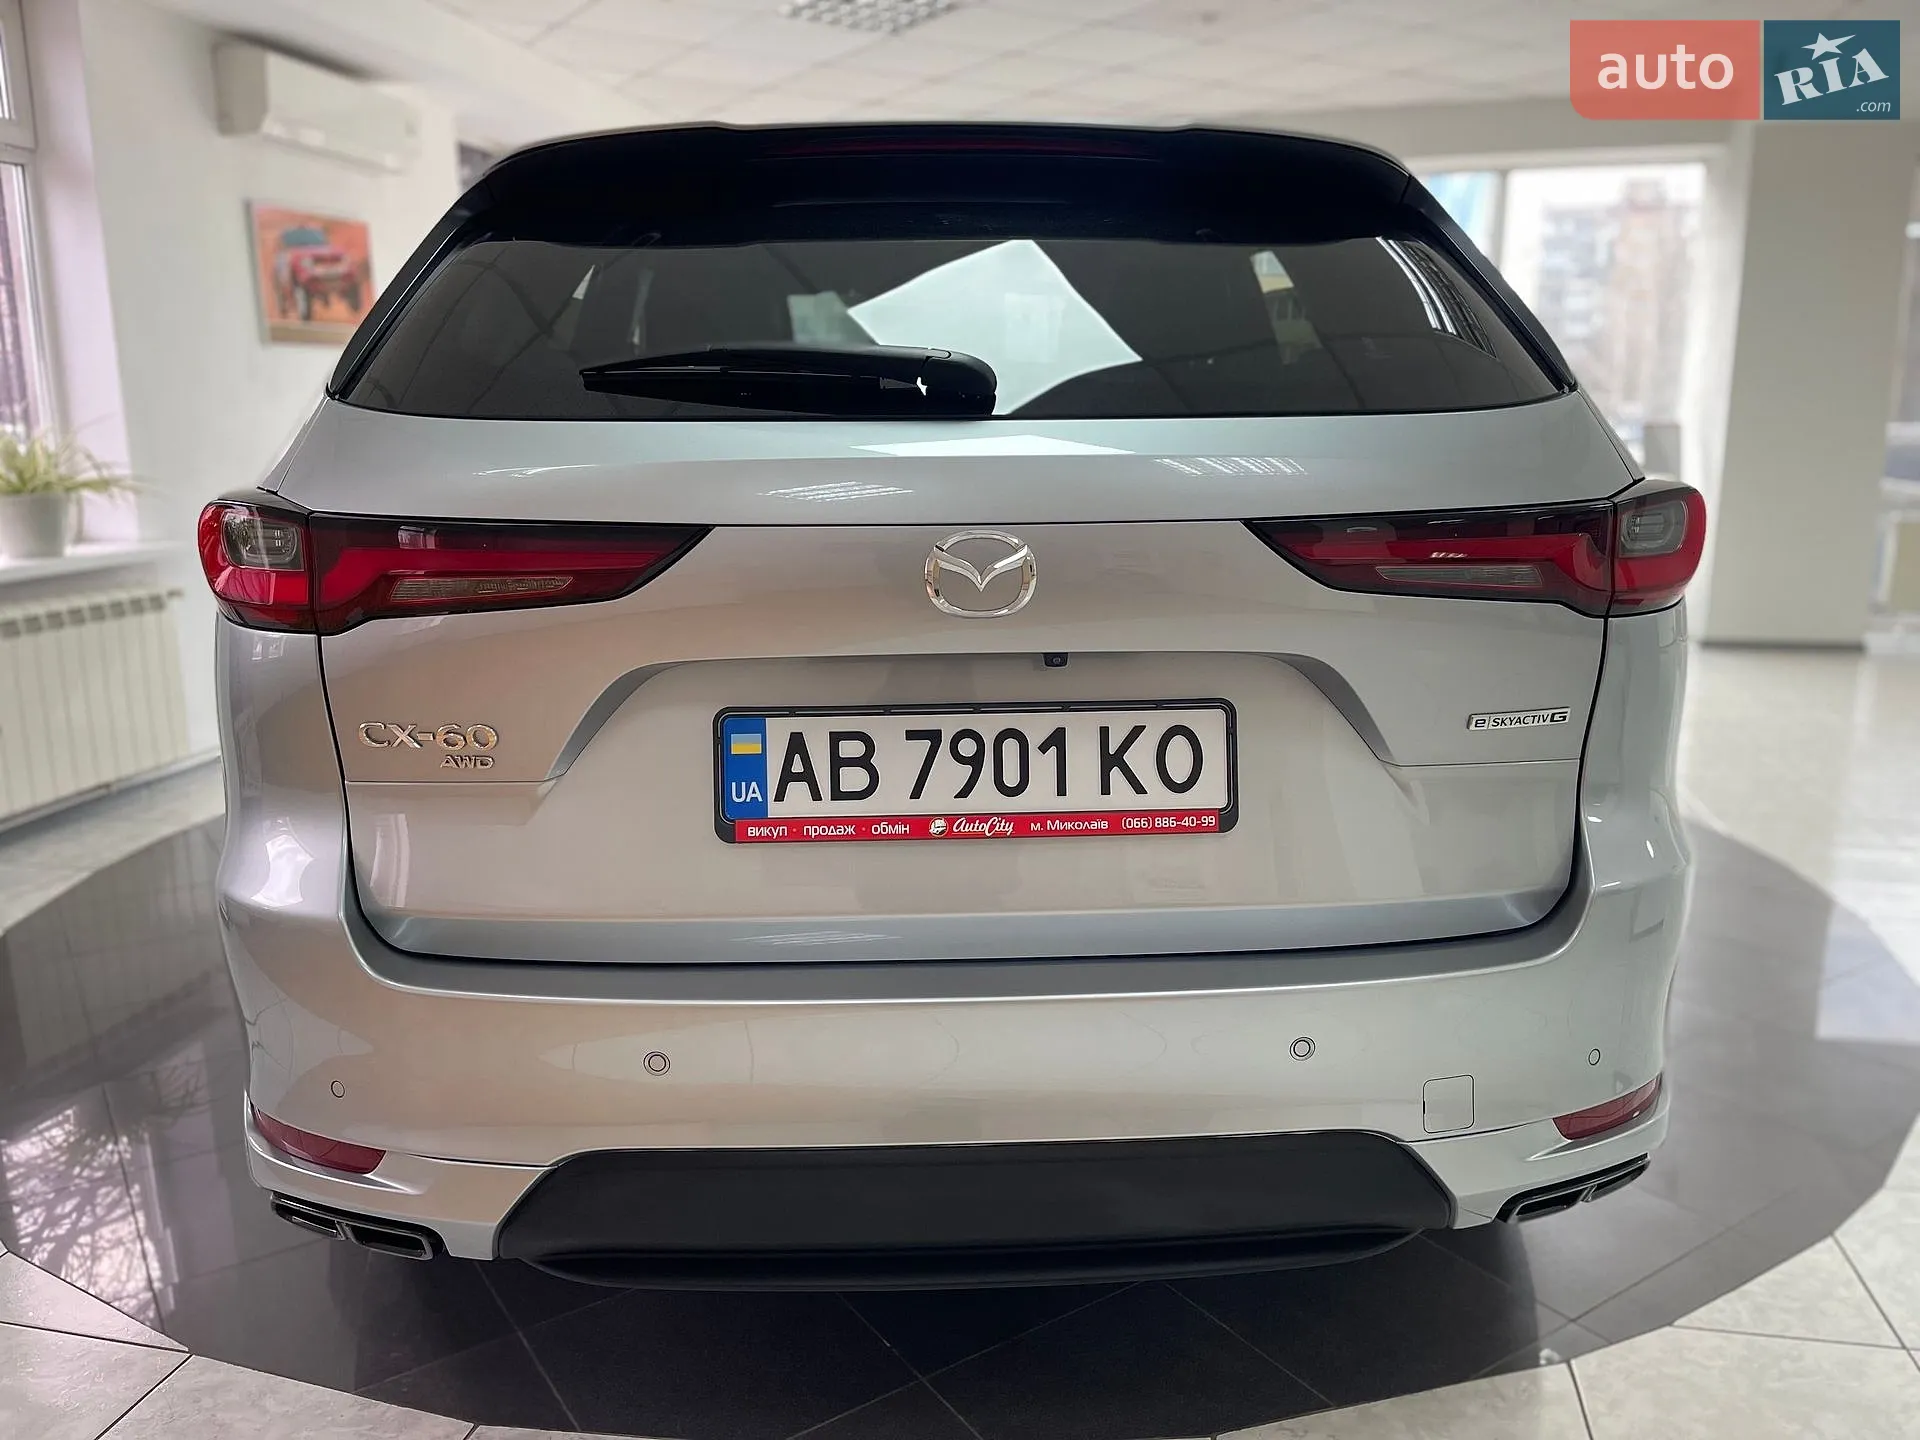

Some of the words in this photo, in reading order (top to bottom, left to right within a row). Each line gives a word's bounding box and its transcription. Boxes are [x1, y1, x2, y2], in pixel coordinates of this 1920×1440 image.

[358, 722, 499, 750] CX-60
[439, 754, 496, 769] AWD
[773, 730, 880, 802] AB
[904, 726, 1067, 799] 7901
[1099, 724, 1204, 795] KO
[731, 781, 763, 802] UA
[747, 826, 788, 839] викуп
[803, 822, 856, 838] продаж
[871, 821, 910, 834] обмін
[1030, 822, 1044, 831] м.
[1046, 818, 1109, 831] Миколаїв
[1121, 816, 1153, 829] (066)
